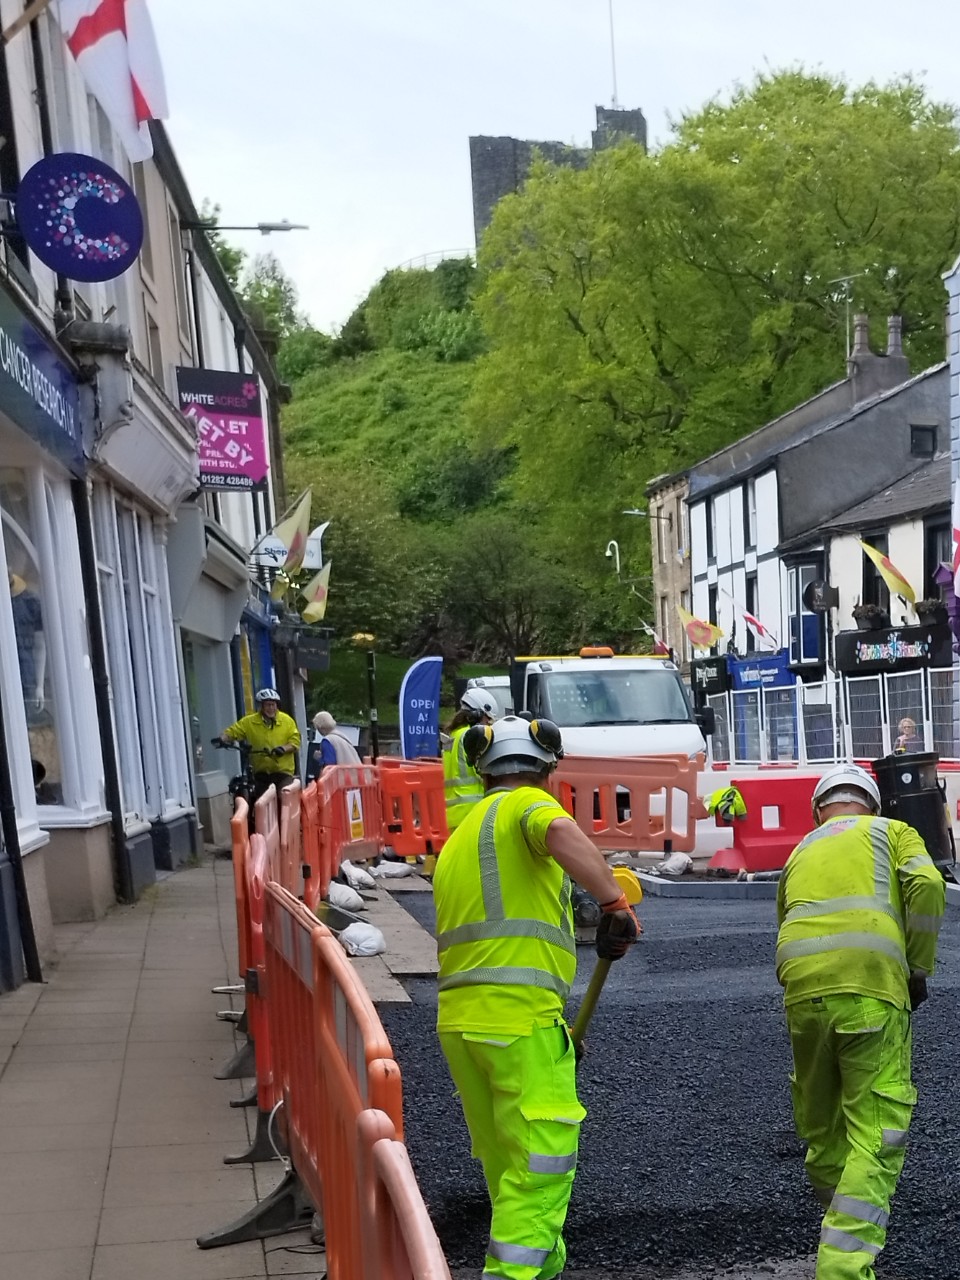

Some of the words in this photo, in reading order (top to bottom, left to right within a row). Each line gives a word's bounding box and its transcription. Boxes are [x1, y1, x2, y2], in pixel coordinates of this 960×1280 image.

[0, 327, 33, 396] CANCER
[32, 363, 67, 432] RESEARCH
[224, 439, 254, 467] BY
[202, 475, 225, 484] 01282
